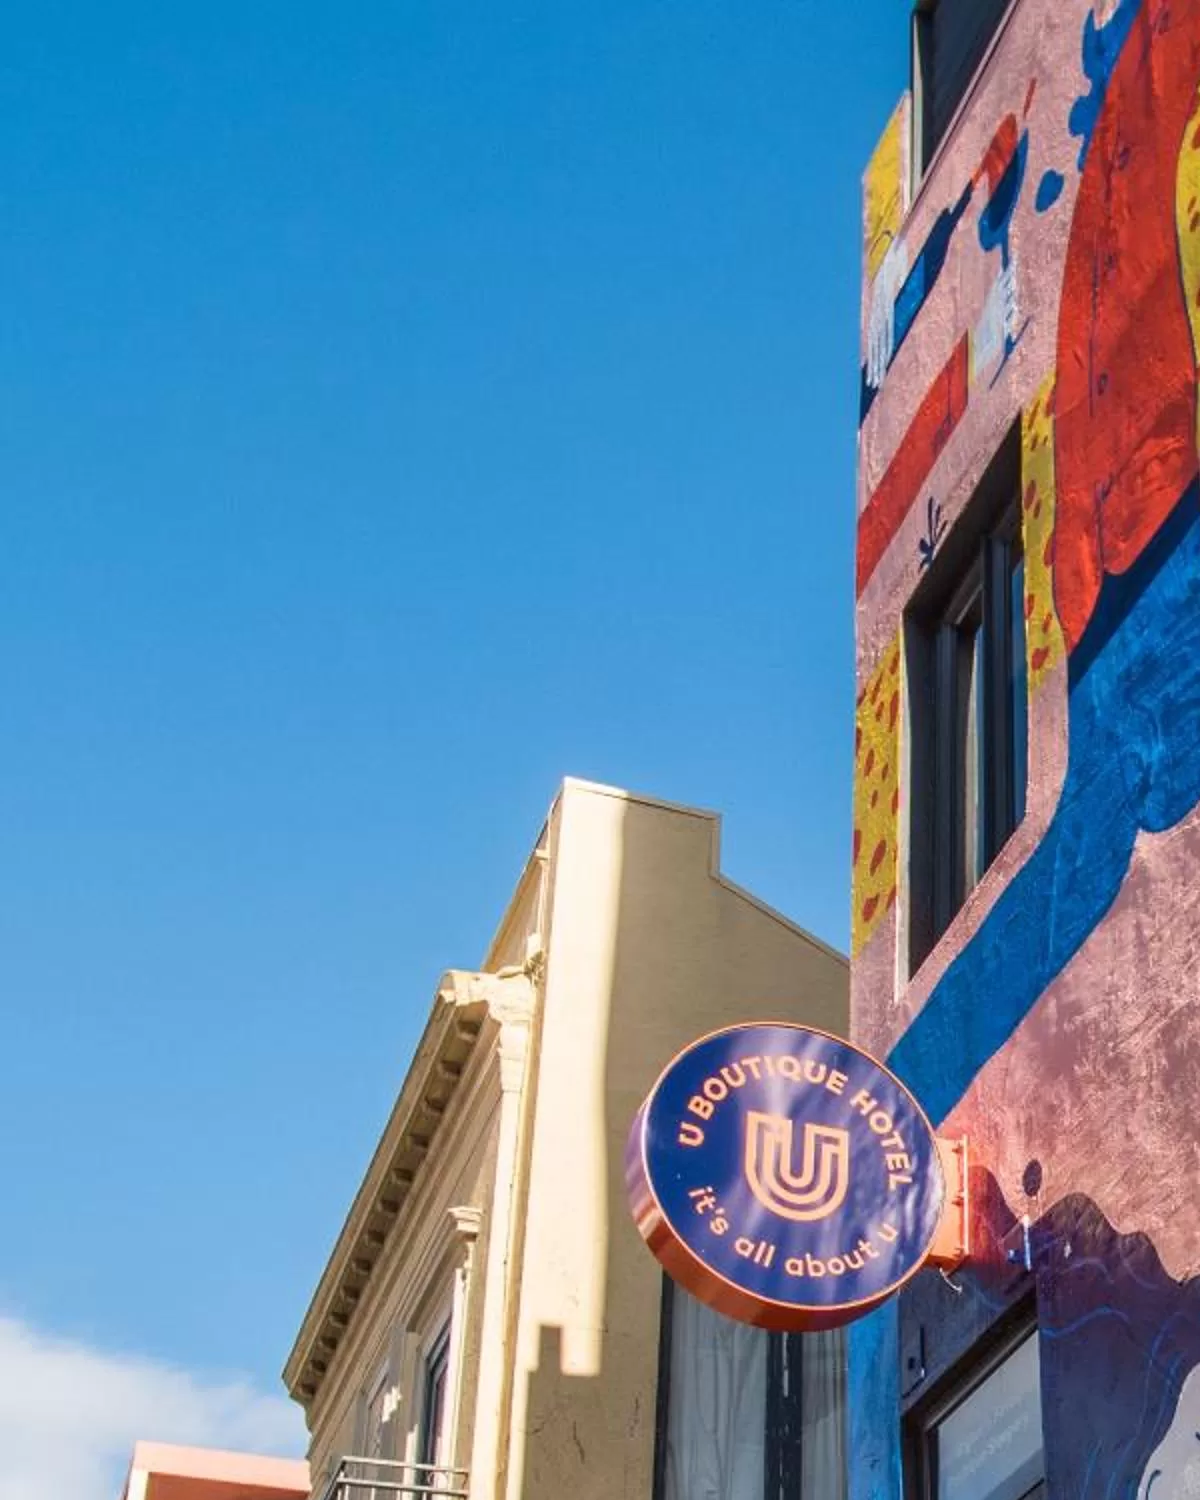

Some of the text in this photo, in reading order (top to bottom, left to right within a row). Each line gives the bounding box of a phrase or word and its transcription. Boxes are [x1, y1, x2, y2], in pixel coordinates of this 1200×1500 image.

[680, 1055, 912, 1190] U BOUTIQUE HOTEL
[746, 1111, 849, 1221] U
[688, 1186, 898, 1277] it's all about u
